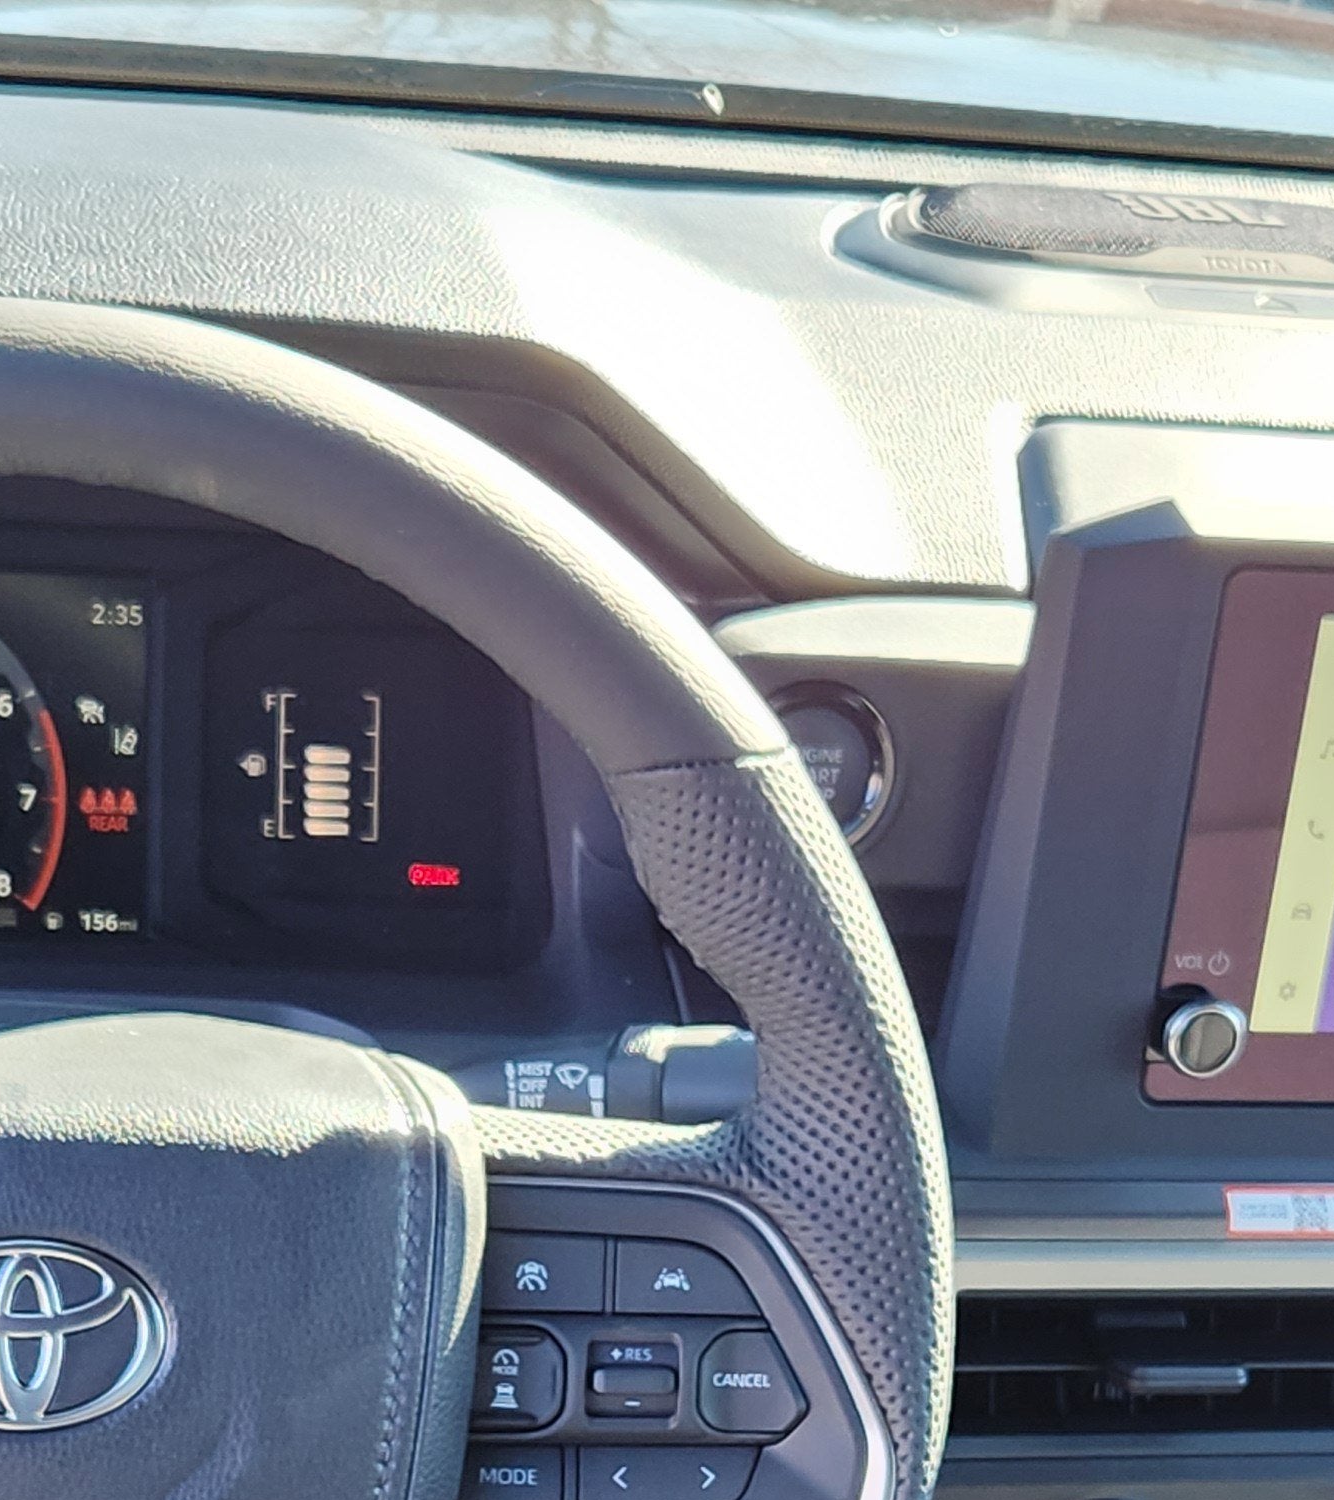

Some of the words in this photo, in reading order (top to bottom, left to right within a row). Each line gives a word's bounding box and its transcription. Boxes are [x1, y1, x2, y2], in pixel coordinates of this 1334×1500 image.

[1102, 190, 1288, 229] JBL
[91, 603, 144, 627] 2:35
[804, 749, 843, 764] GINE
[18, 785, 37, 811] 7
[87, 815, 129, 833] REAR
[79, 910, 118, 932] 156
[1175, 954, 1204, 970] VOL
[518, 1062, 554, 1077] MIST
[519, 1079, 548, 1093] OFF
[519, 1095, 546, 1109] INT
[712, 1373, 771, 1389] CANCEL
[479, 1467, 538, 1486] MODE
